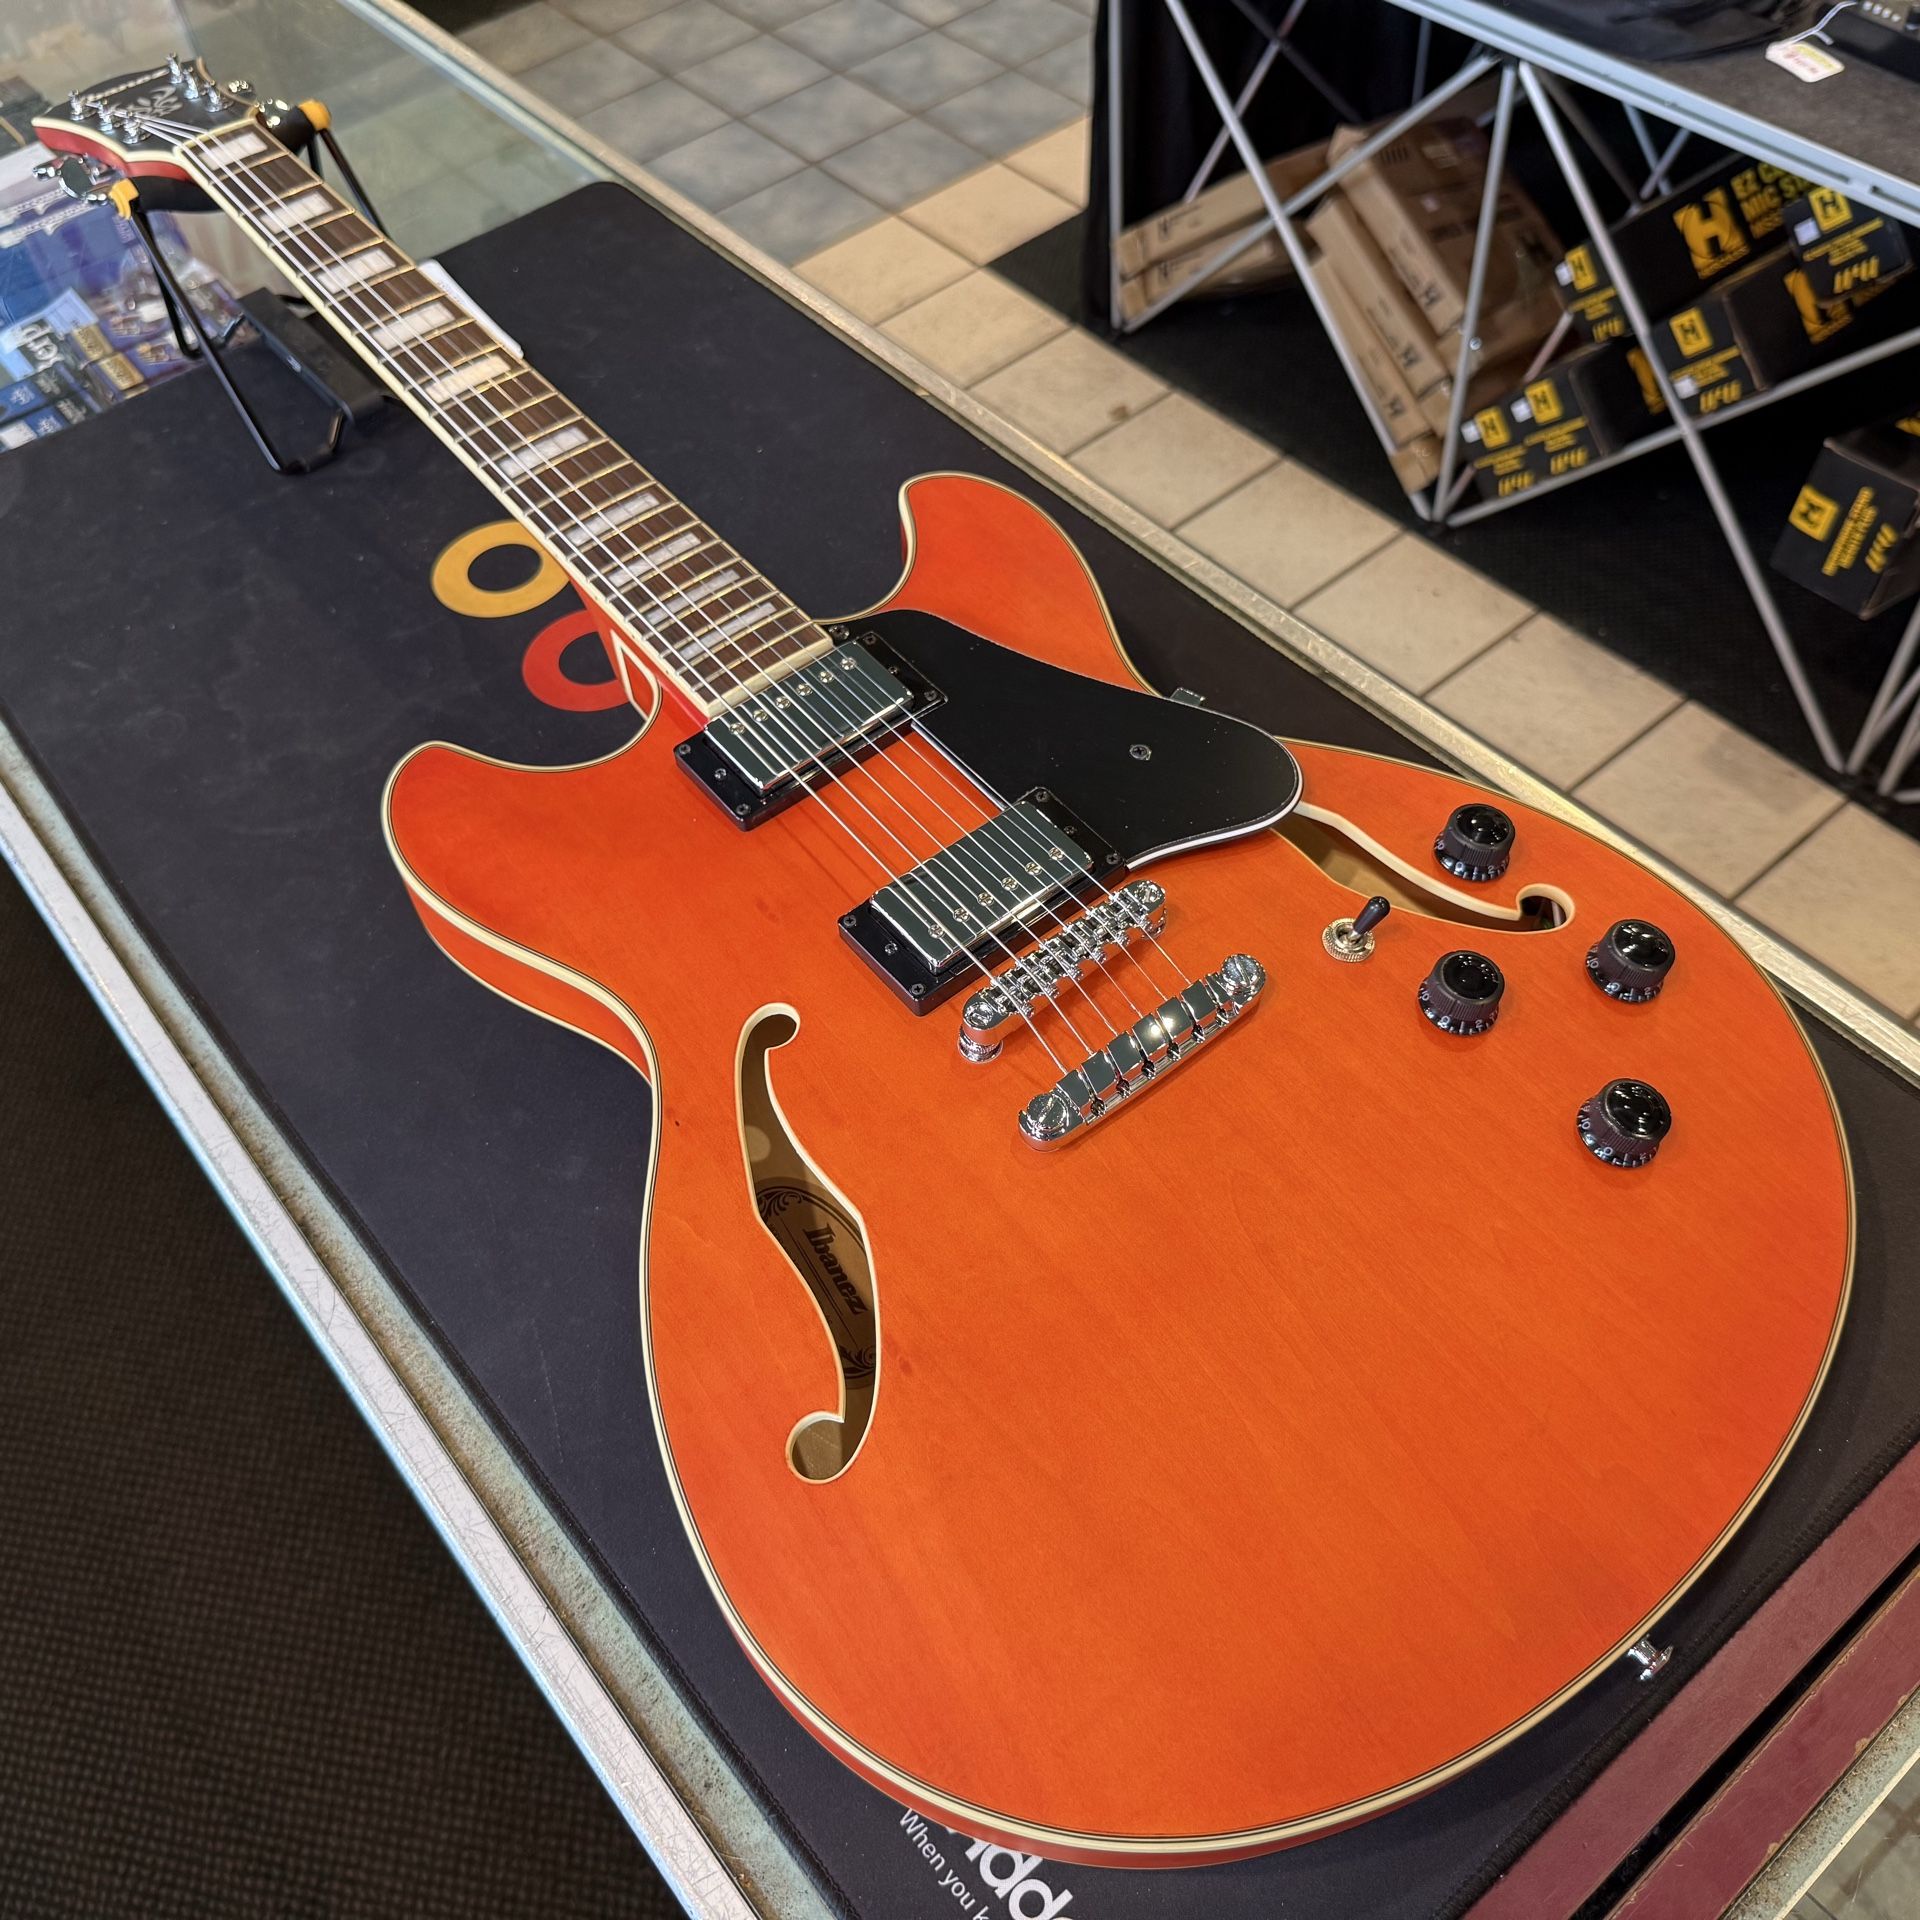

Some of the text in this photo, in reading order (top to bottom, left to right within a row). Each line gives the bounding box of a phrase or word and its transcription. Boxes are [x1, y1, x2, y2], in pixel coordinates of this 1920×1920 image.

[803, 1222, 868, 1314] Ibanez
[899, 1808, 946, 1871] When
[938, 1868, 977, 1911] you
